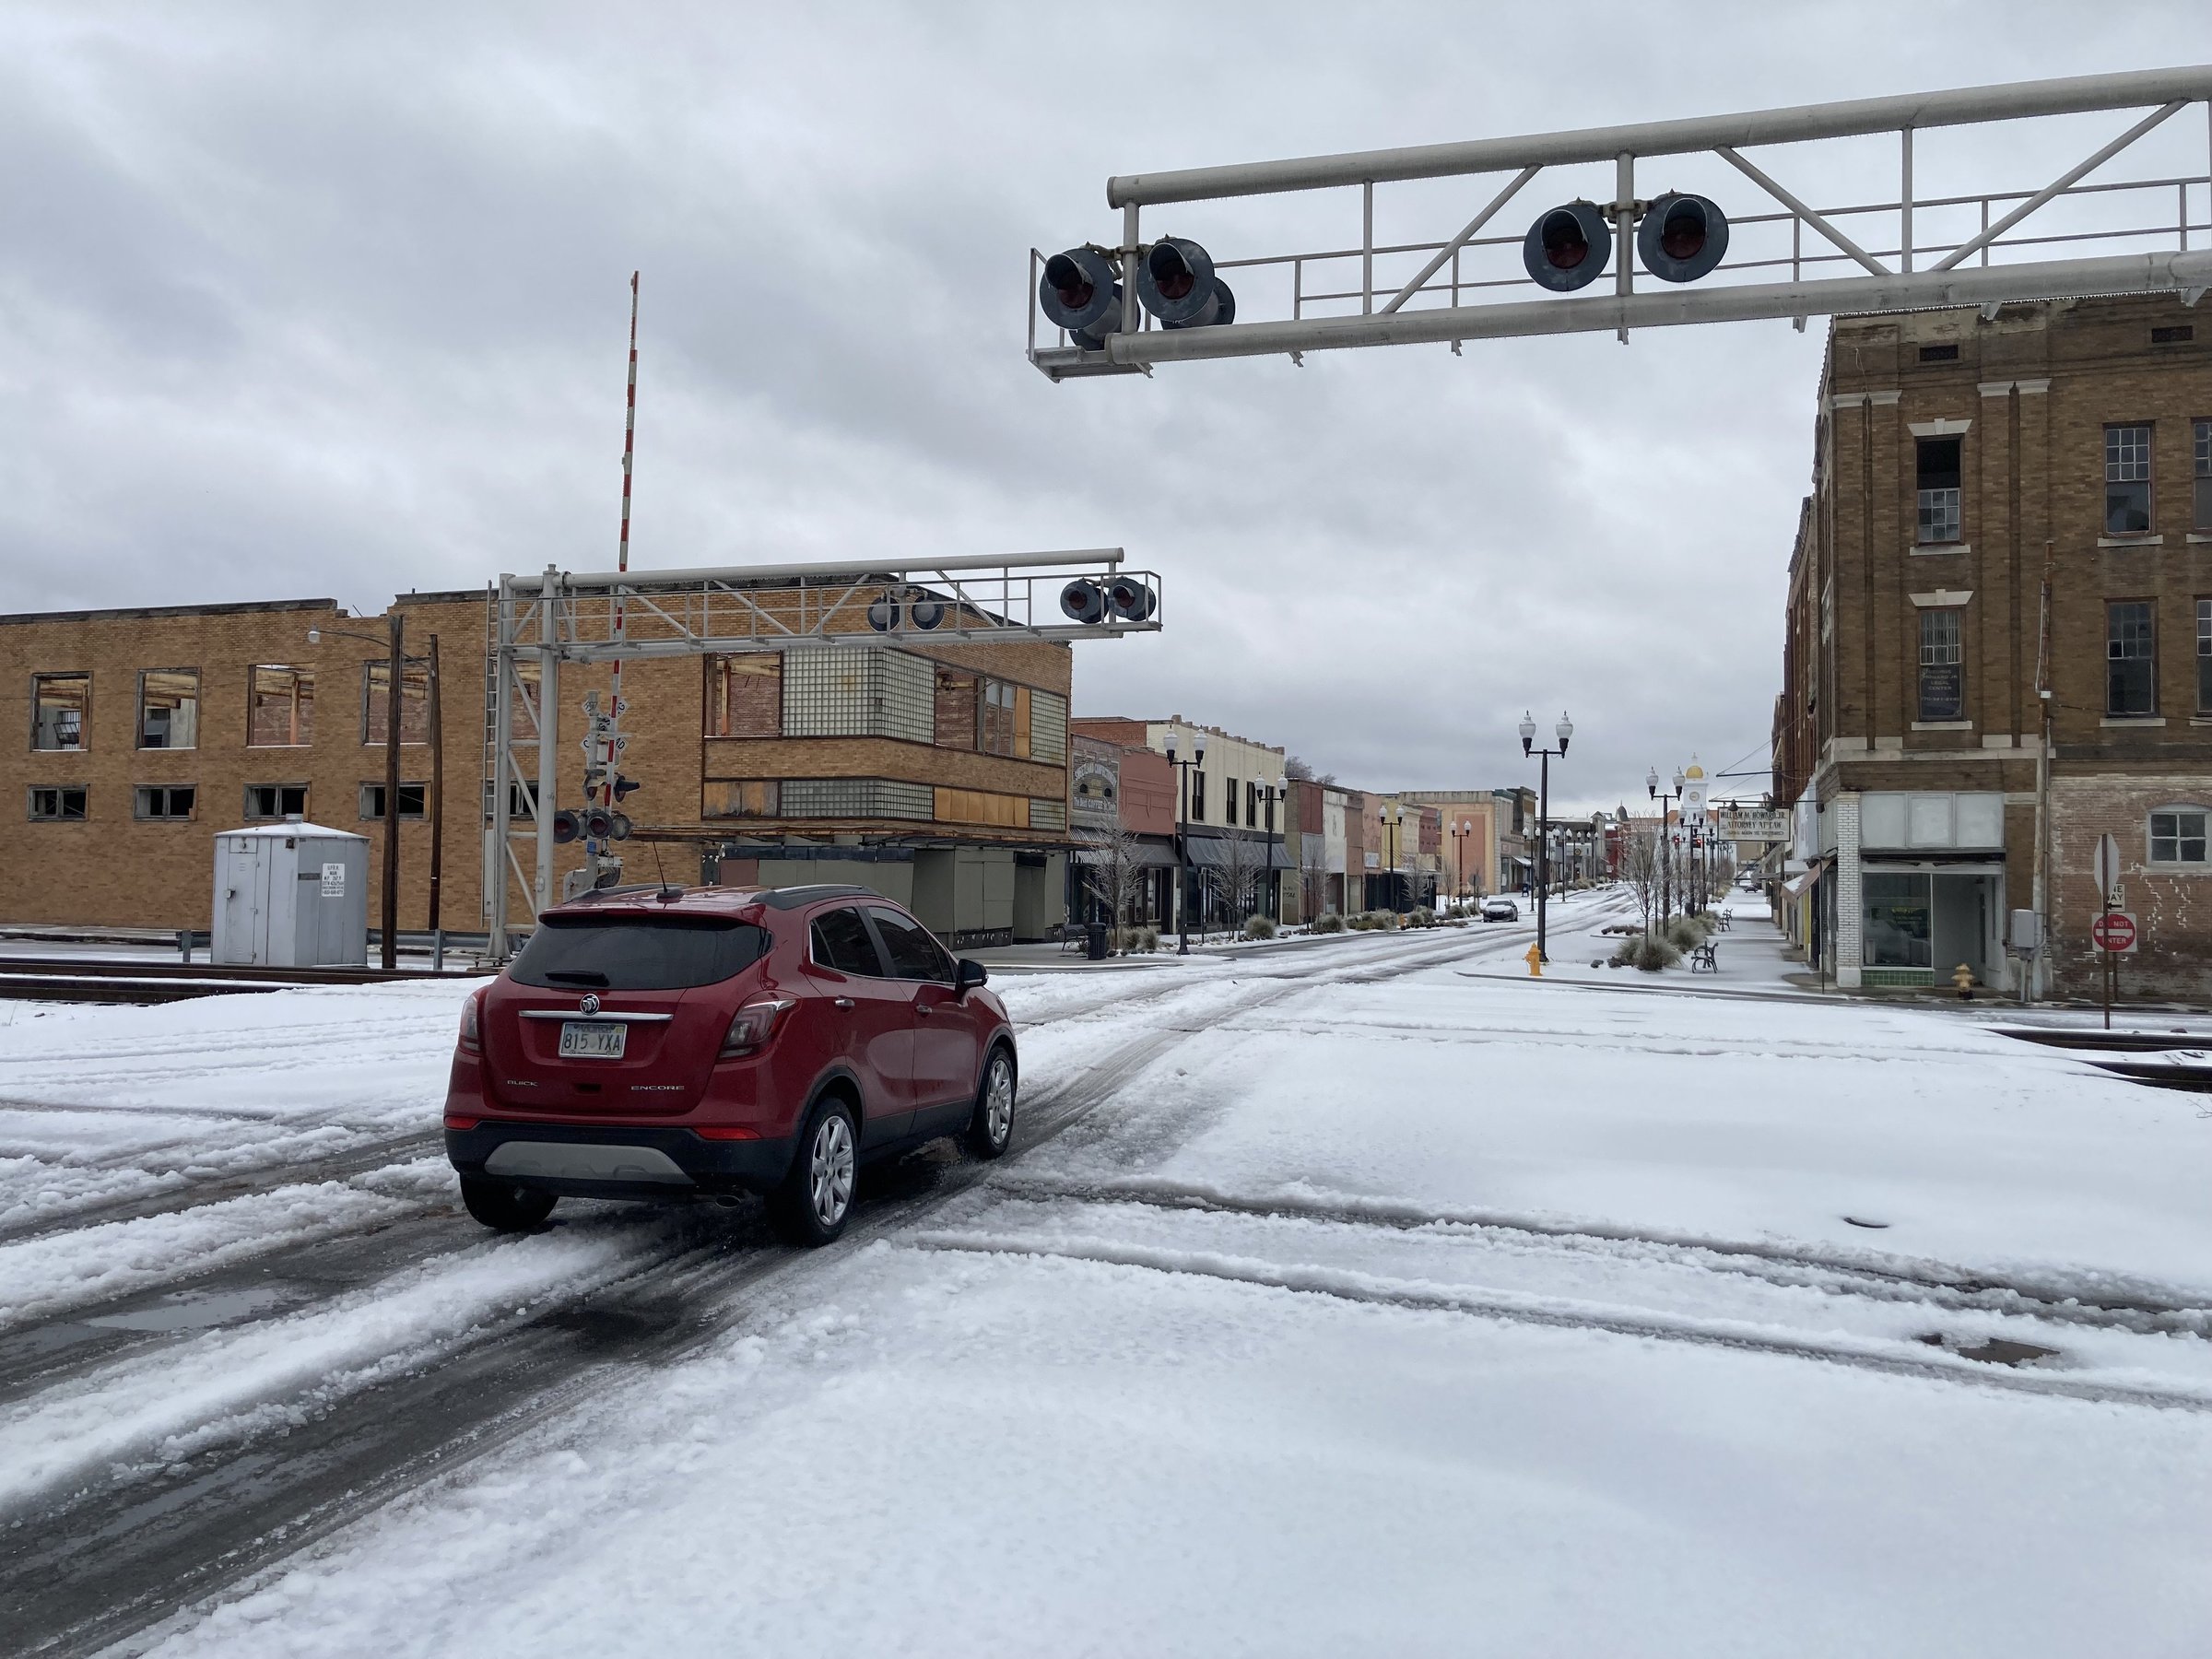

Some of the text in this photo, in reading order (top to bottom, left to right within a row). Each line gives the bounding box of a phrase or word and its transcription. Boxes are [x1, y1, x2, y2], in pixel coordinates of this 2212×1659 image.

[1720, 811, 1743, 819] WILLIAM
[564, 1033, 620, 1051] 815 YXA
